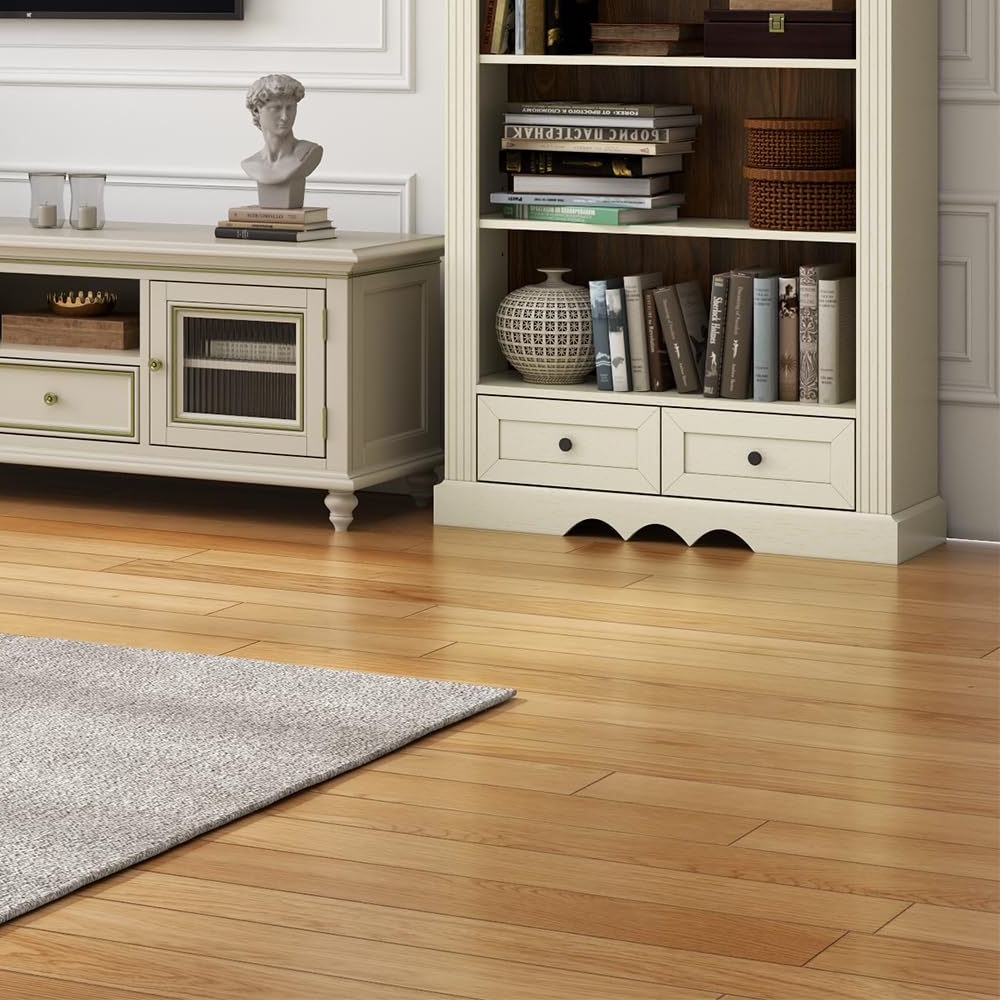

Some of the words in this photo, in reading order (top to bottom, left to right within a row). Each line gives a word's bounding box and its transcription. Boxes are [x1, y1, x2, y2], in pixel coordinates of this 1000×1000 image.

[513, 127, 603, 140] ПАСТЕРНАК
[608, 129, 659, 142] БОРИС
[712, 296, 723, 321] Sherlock
[710, 323, 720, 344] Holmes
